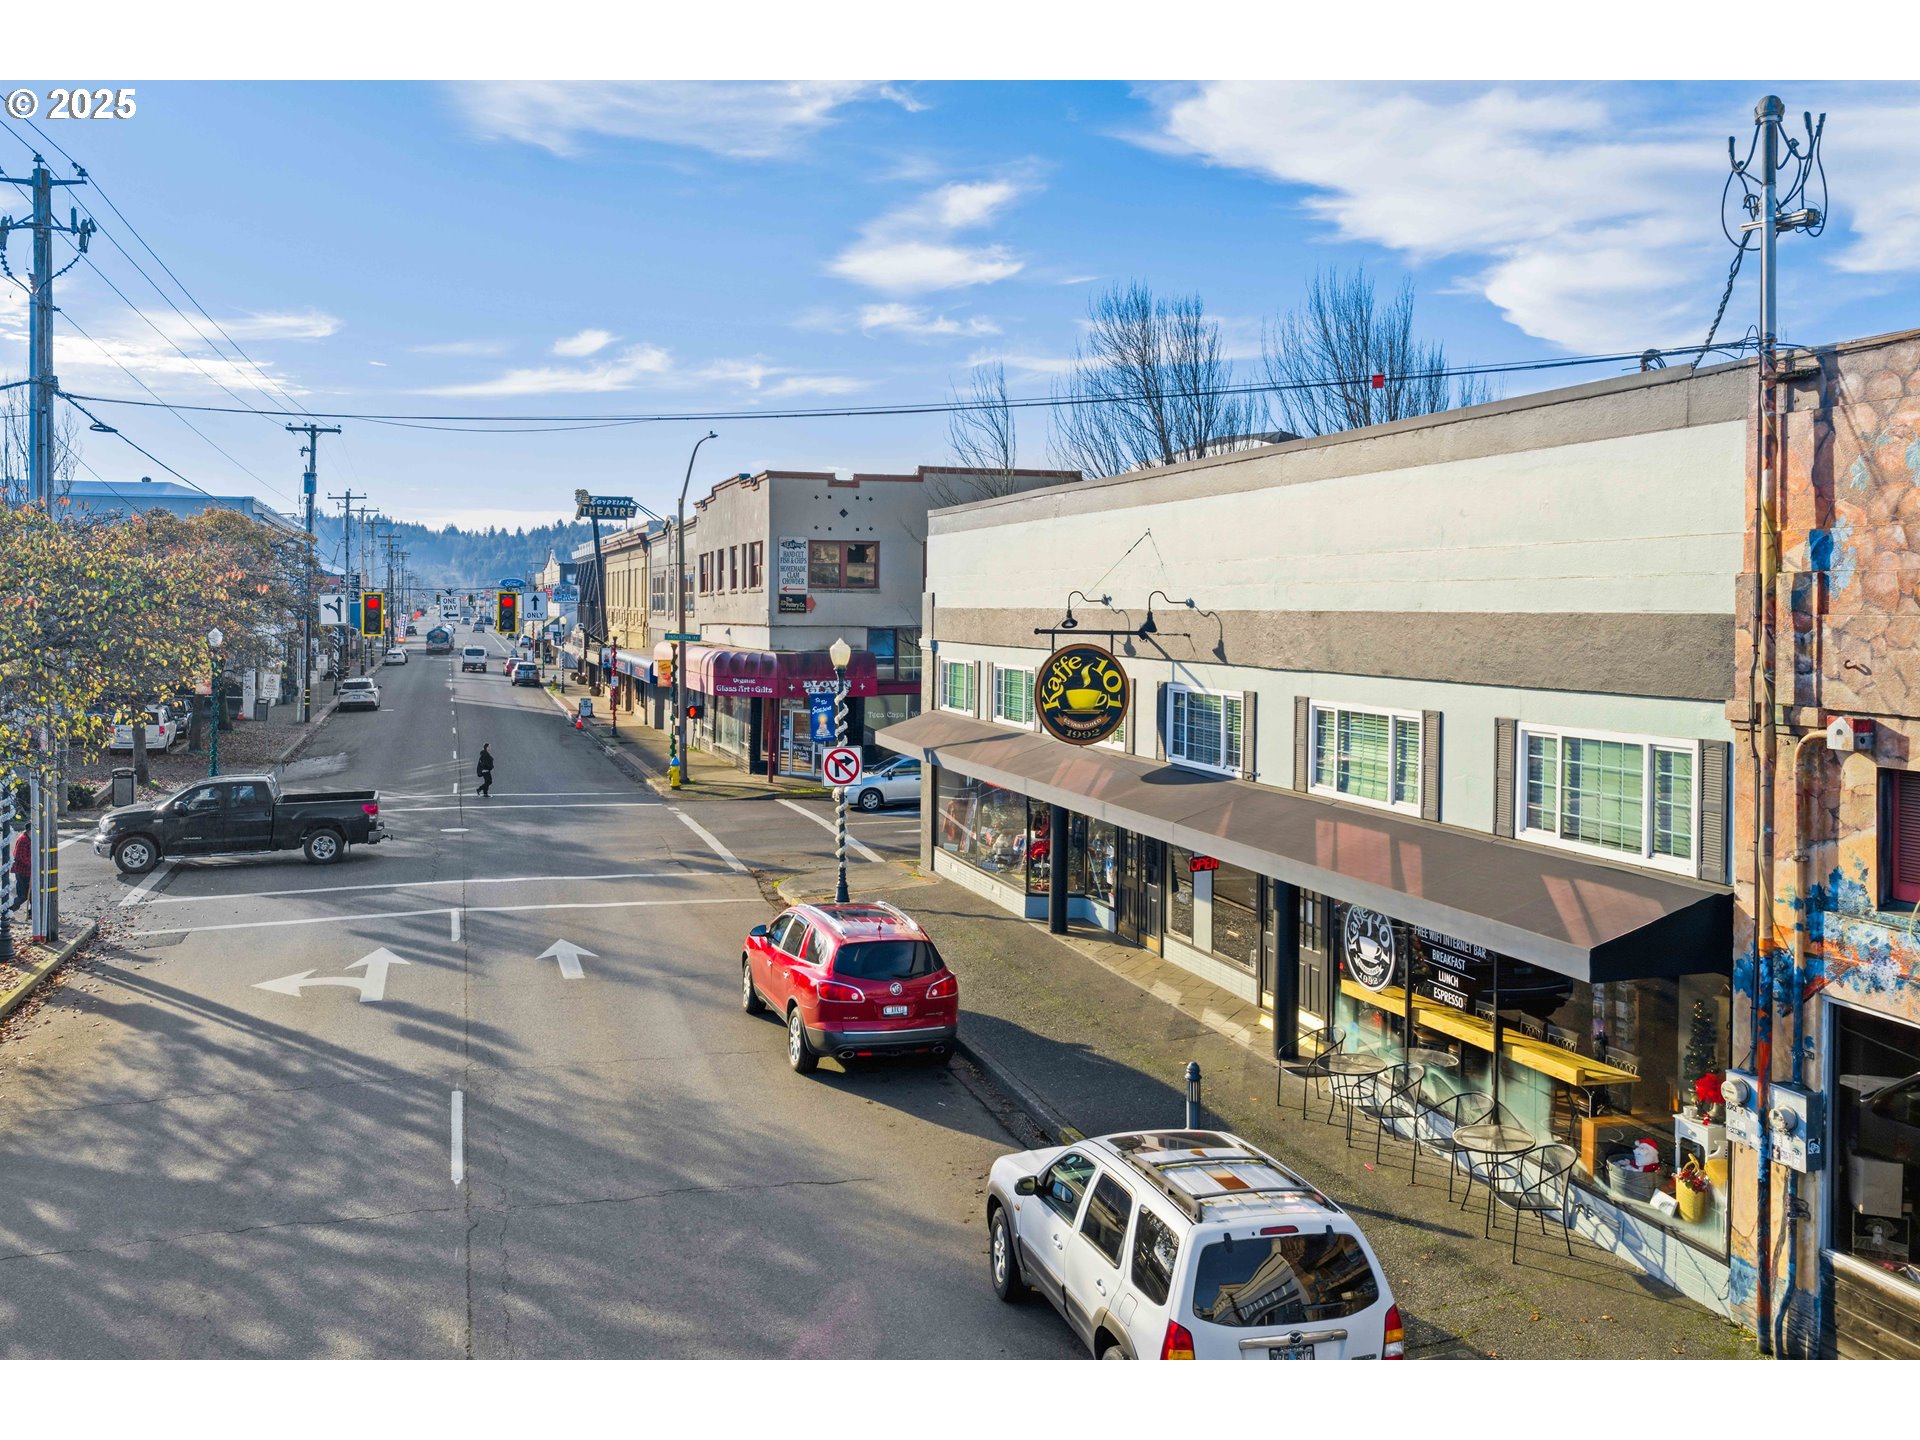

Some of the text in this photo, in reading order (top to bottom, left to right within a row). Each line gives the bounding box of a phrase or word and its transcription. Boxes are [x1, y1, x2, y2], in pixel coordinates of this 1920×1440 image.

[582, 506, 634, 517] THEATRE
[716, 684, 737, 692] Glass
[802, 680, 852, 688] BLOWN
[1042, 655, 1123, 713] Kaffe 101
[811, 705, 832, 715] Season
[886, 711, 905, 720] Caps
[1066, 728, 1100, 739] 1992
[1190, 858, 1219, 871] OPEN
[1414, 925, 1487, 959] FREE WIFI INTERNET BAR
[1432, 949, 1466, 971] BREAKFAST
[1438, 970, 1459, 988] LUNCH
[1433, 986, 1464, 1009] ESPRESSO
